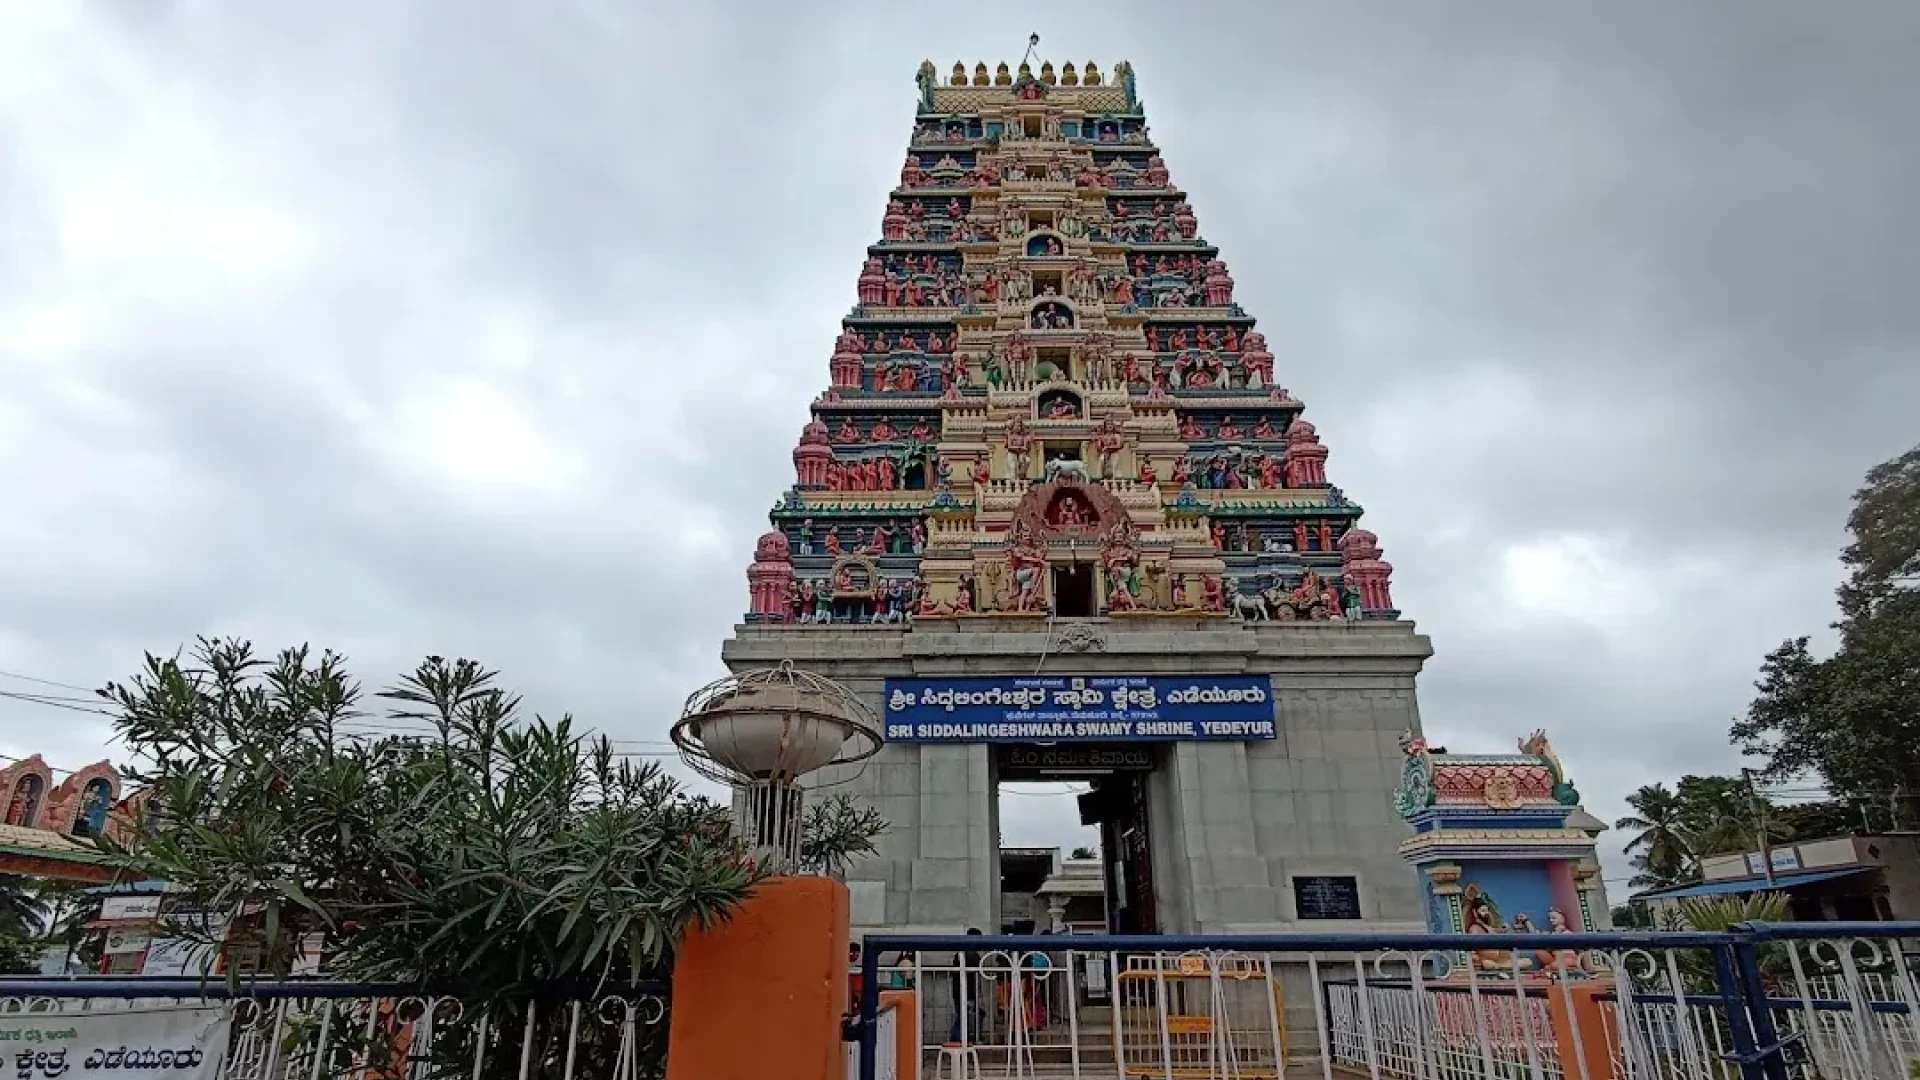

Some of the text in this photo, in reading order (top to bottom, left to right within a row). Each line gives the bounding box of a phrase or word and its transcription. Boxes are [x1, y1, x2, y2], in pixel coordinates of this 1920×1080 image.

[888, 721, 1274, 738] SRI SIDDALINGESHWARA SWAMY SHRINE, YEDEYUR
